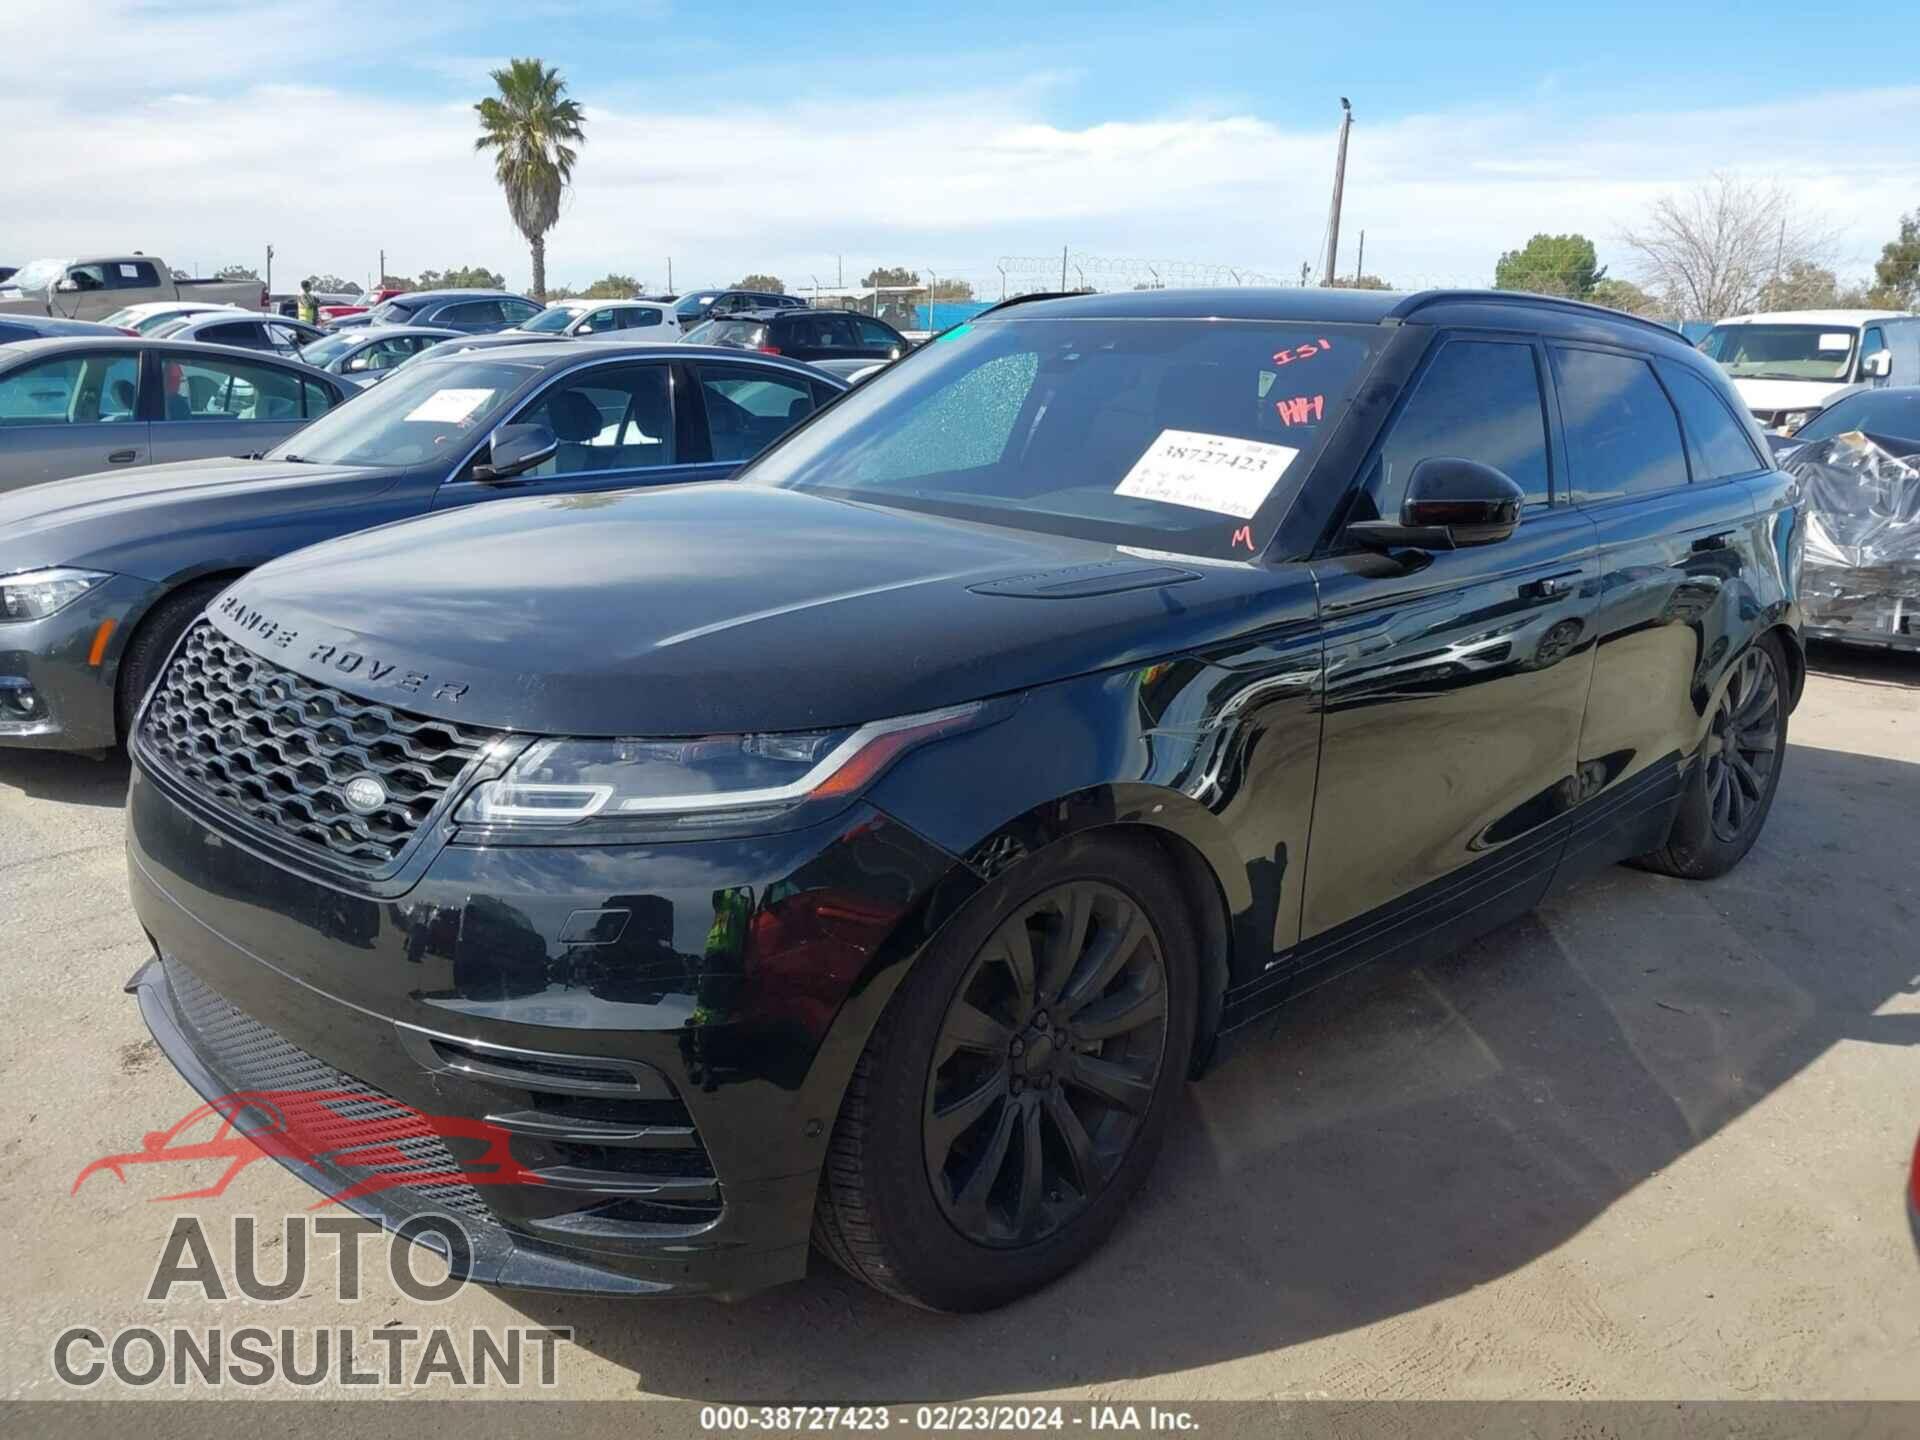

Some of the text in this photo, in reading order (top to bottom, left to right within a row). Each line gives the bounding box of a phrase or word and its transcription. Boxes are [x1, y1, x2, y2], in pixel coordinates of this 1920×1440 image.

[1159, 444, 1268, 472] 38727423
[219, 597, 470, 704] RANGE ROVER
